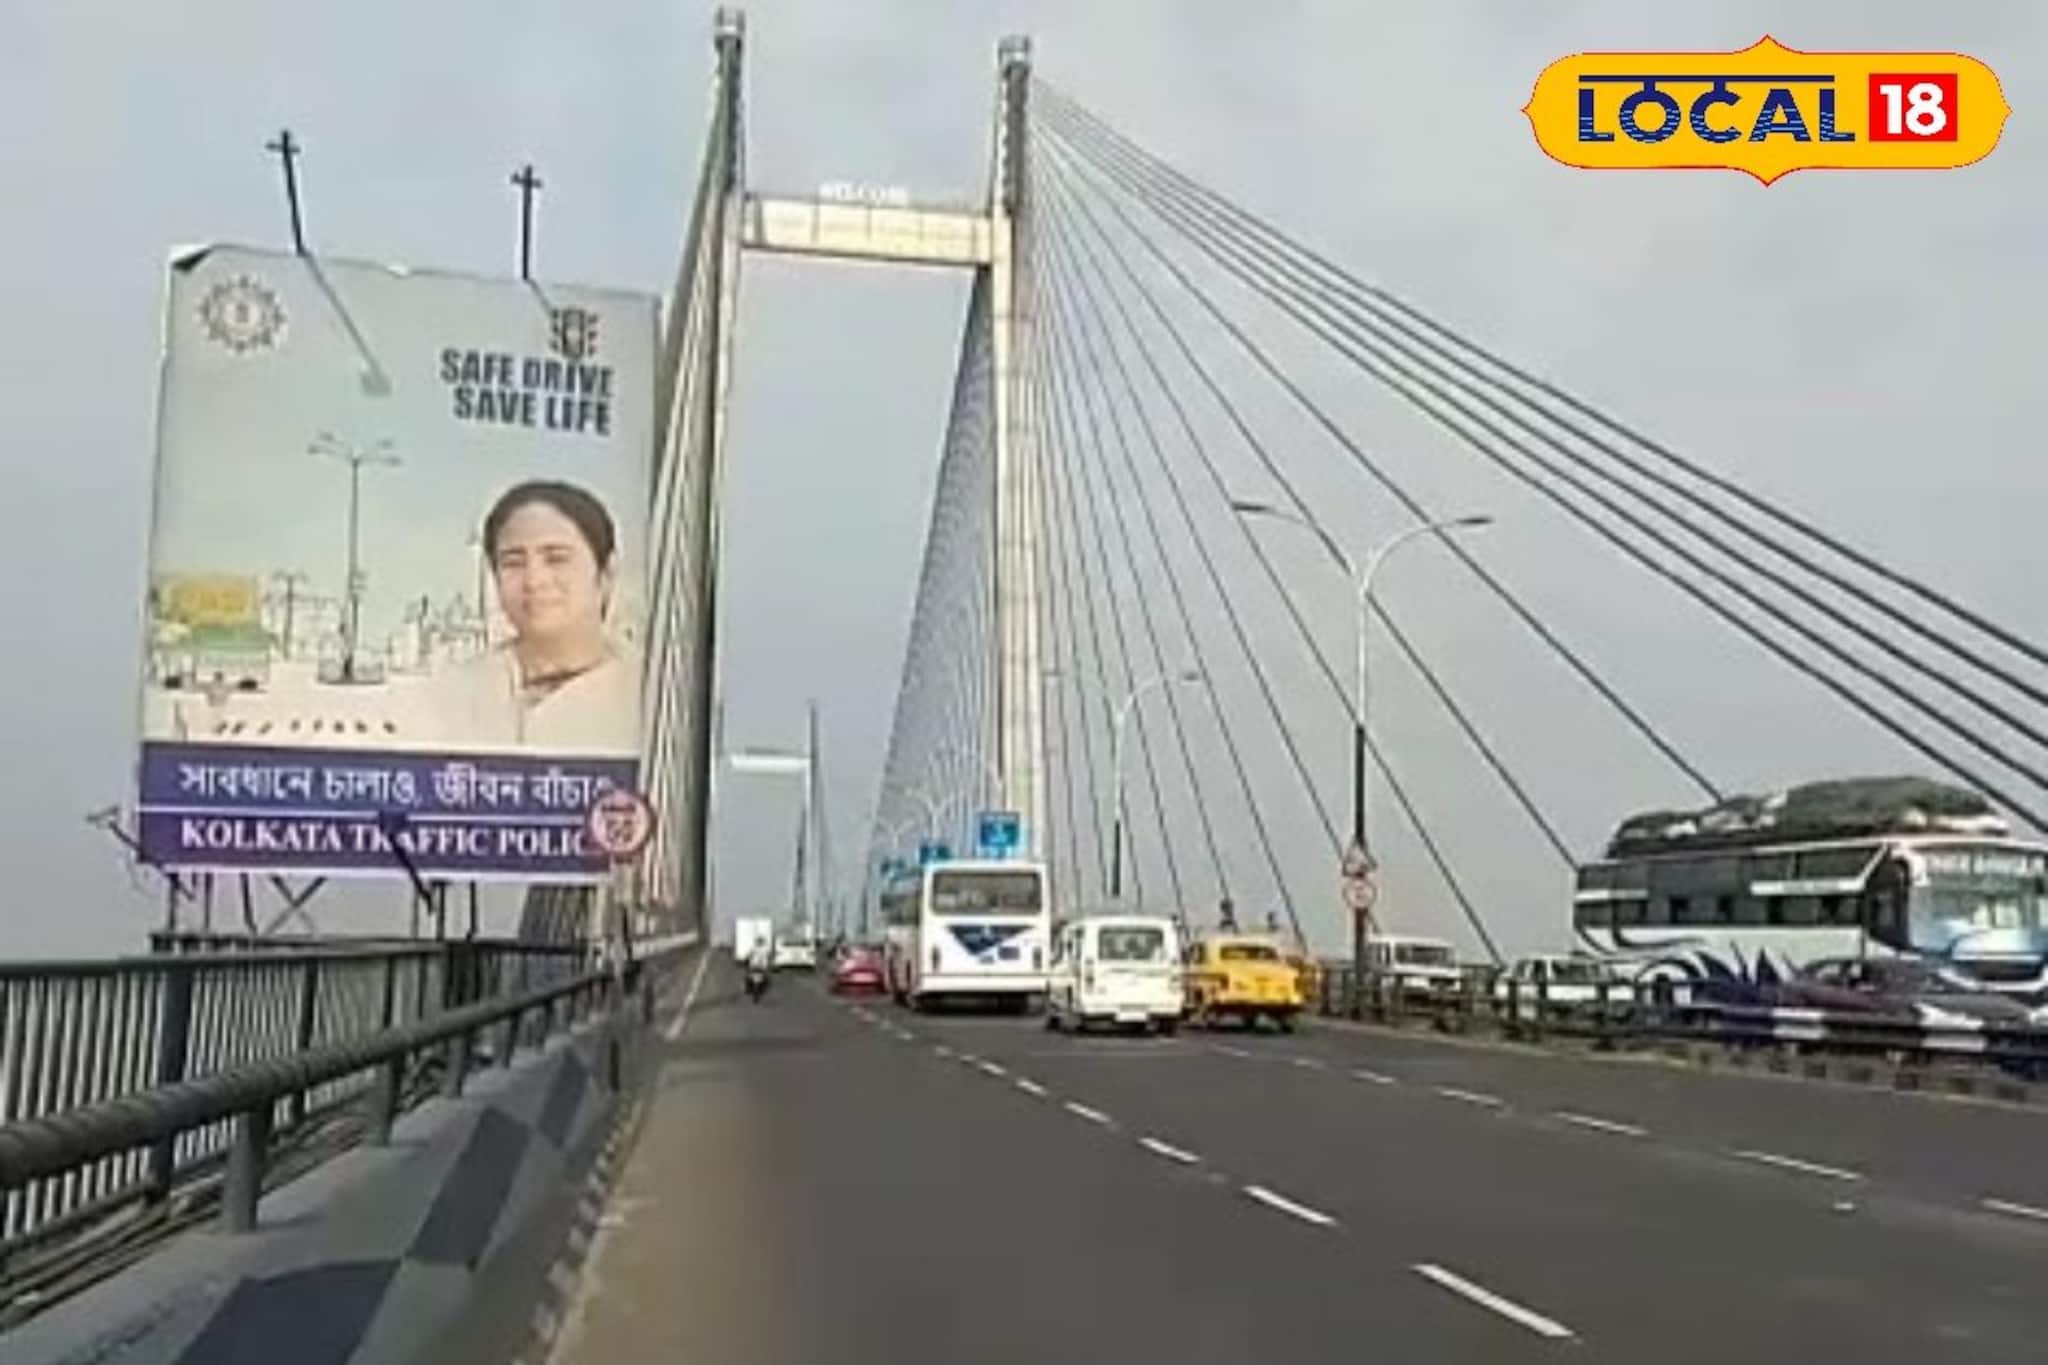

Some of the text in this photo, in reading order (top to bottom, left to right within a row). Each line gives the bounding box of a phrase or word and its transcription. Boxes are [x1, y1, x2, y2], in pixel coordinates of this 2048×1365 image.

[439, 349, 613, 398] SAFE DRIVE
[453, 386, 611, 437] SAVE LIFE
[179, 763, 313, 799] সাবধানে
[432, 762, 524, 808] জীবন
[181, 819, 602, 857] KOLKATA TRAFFIC POLIC
